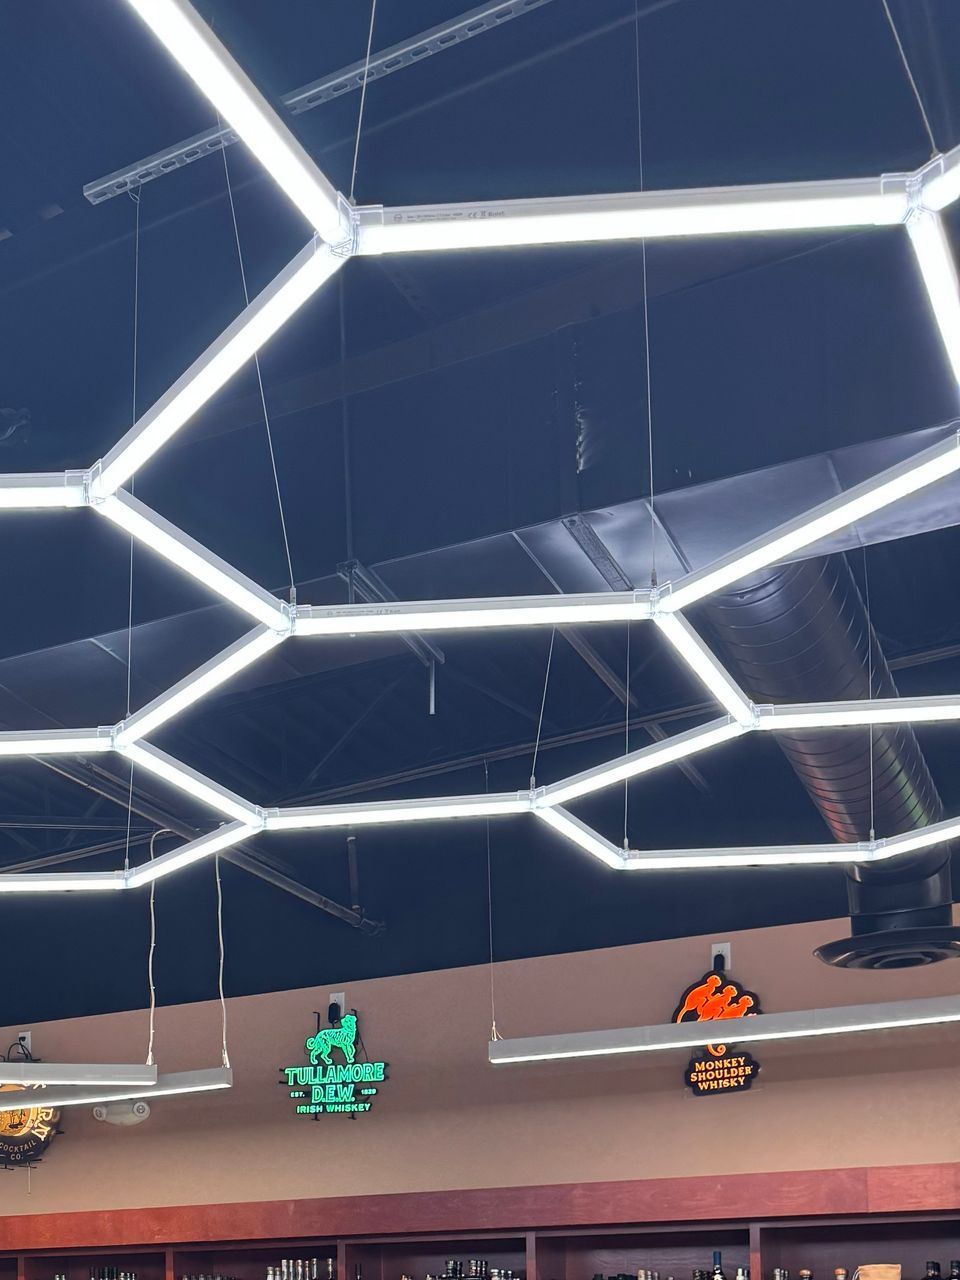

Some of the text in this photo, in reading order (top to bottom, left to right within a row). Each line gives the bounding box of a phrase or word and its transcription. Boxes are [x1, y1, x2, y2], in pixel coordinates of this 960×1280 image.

[694, 1056, 746, 1072] MONKEY
[285, 1062, 385, 1086] TULLAMORE
[690, 1066, 752, 1082] SHOULDER
[698, 1077, 746, 1090] WHISKY
[311, 1084, 356, 1103] D.E.W.
[296, 1103, 371, 1114] IRISH WHISKEY
